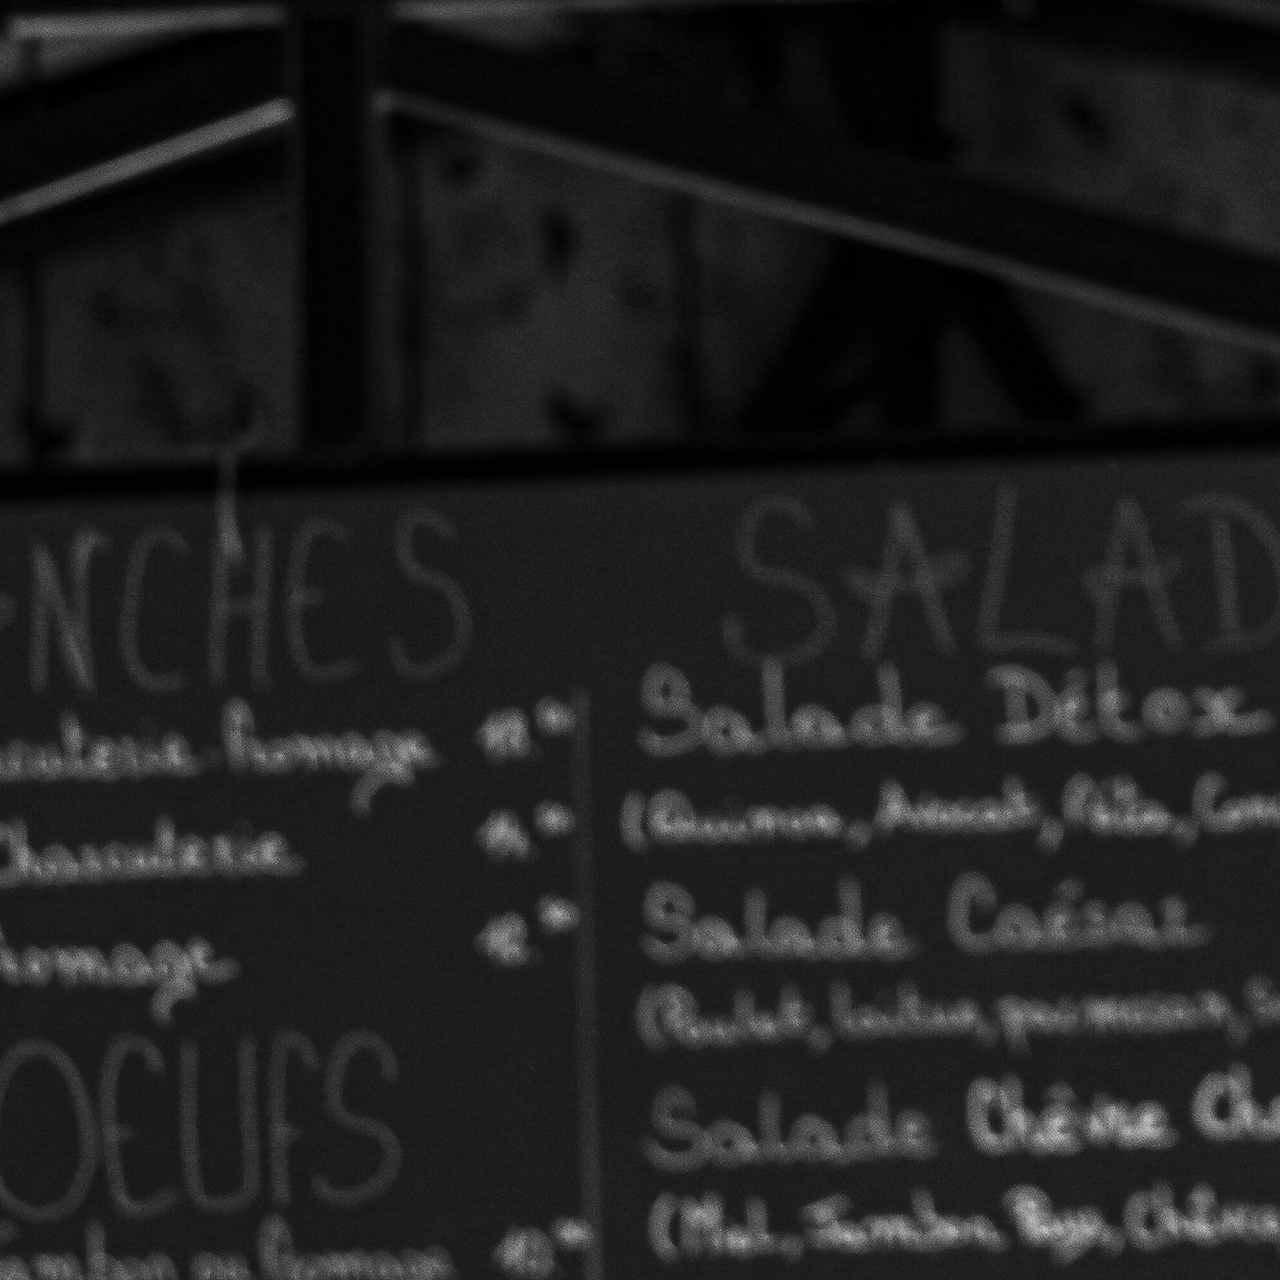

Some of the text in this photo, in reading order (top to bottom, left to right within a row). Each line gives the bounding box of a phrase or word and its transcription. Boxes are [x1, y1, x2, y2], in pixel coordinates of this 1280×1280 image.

[637, 657, 967, 758] Salade
[640, 874, 919, 962] Salade
[641, 1075, 940, 1172] Salade
